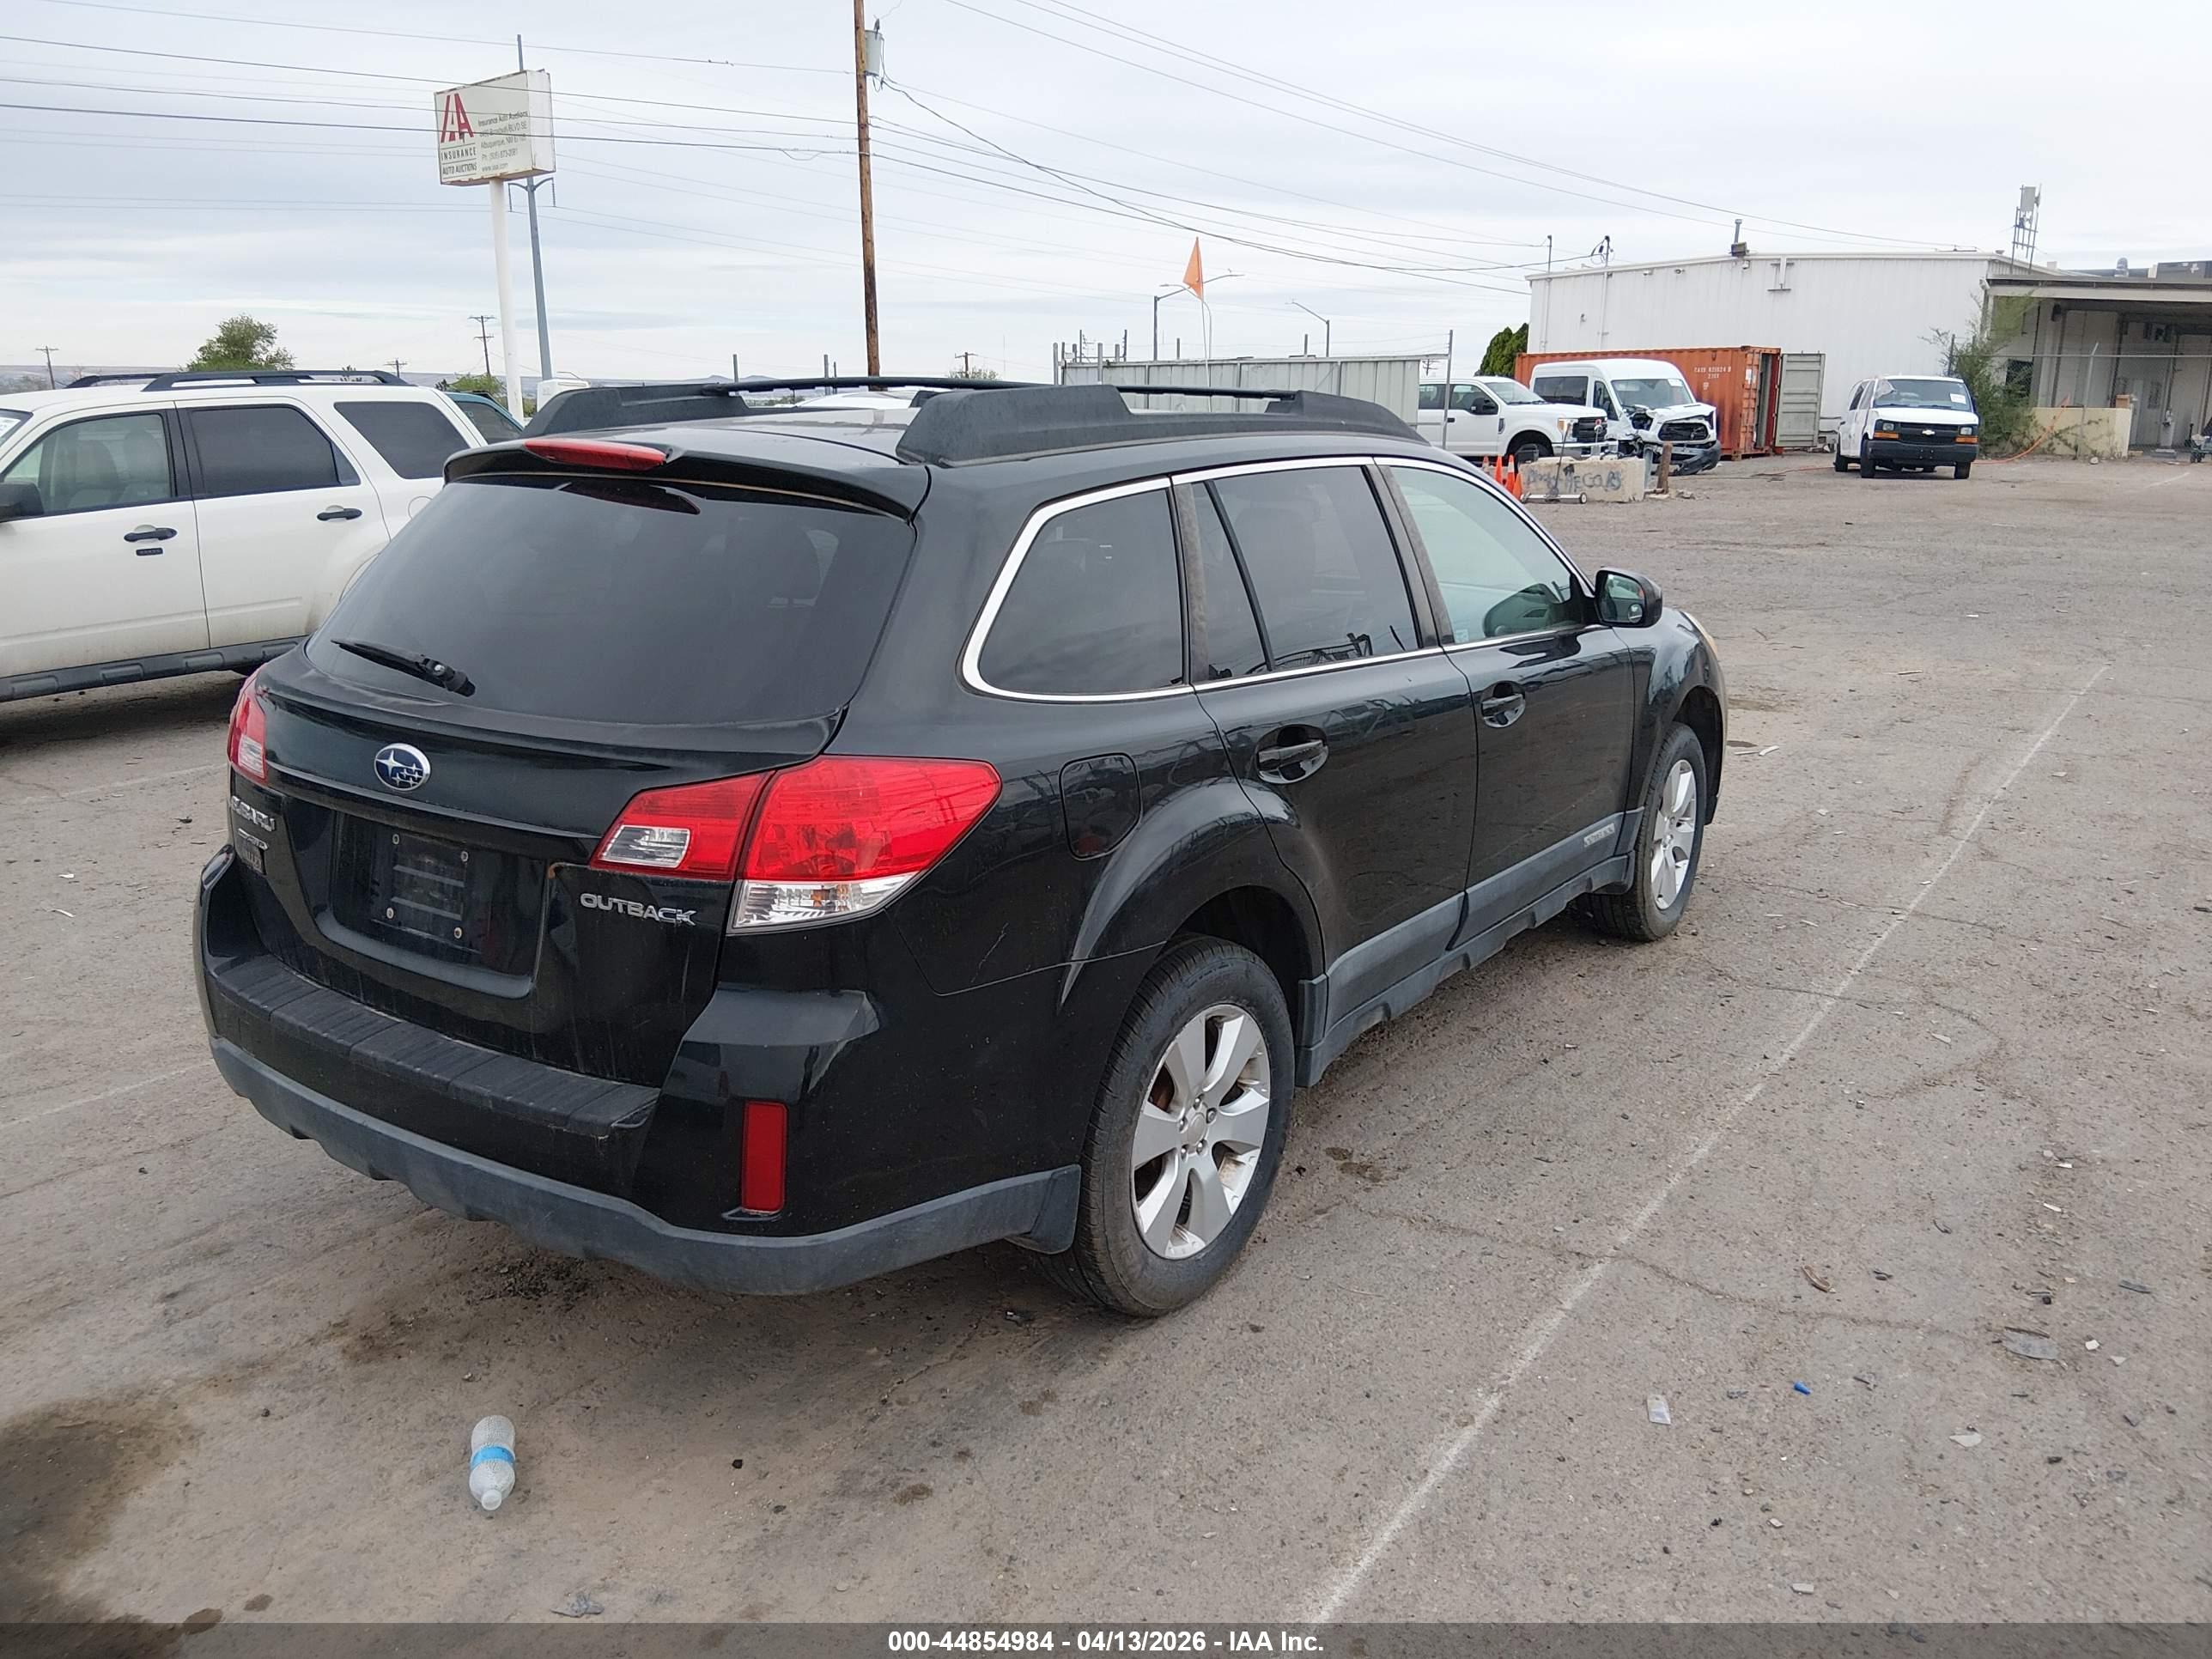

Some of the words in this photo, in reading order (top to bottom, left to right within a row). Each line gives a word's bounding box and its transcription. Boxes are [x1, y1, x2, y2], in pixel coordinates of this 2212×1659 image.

[441, 147, 477, 161] INSURANCE
[442, 164, 455, 175] AUTO
[455, 162, 477, 173] AUCTIONS
[580, 892, 697, 927] OUTBACK
